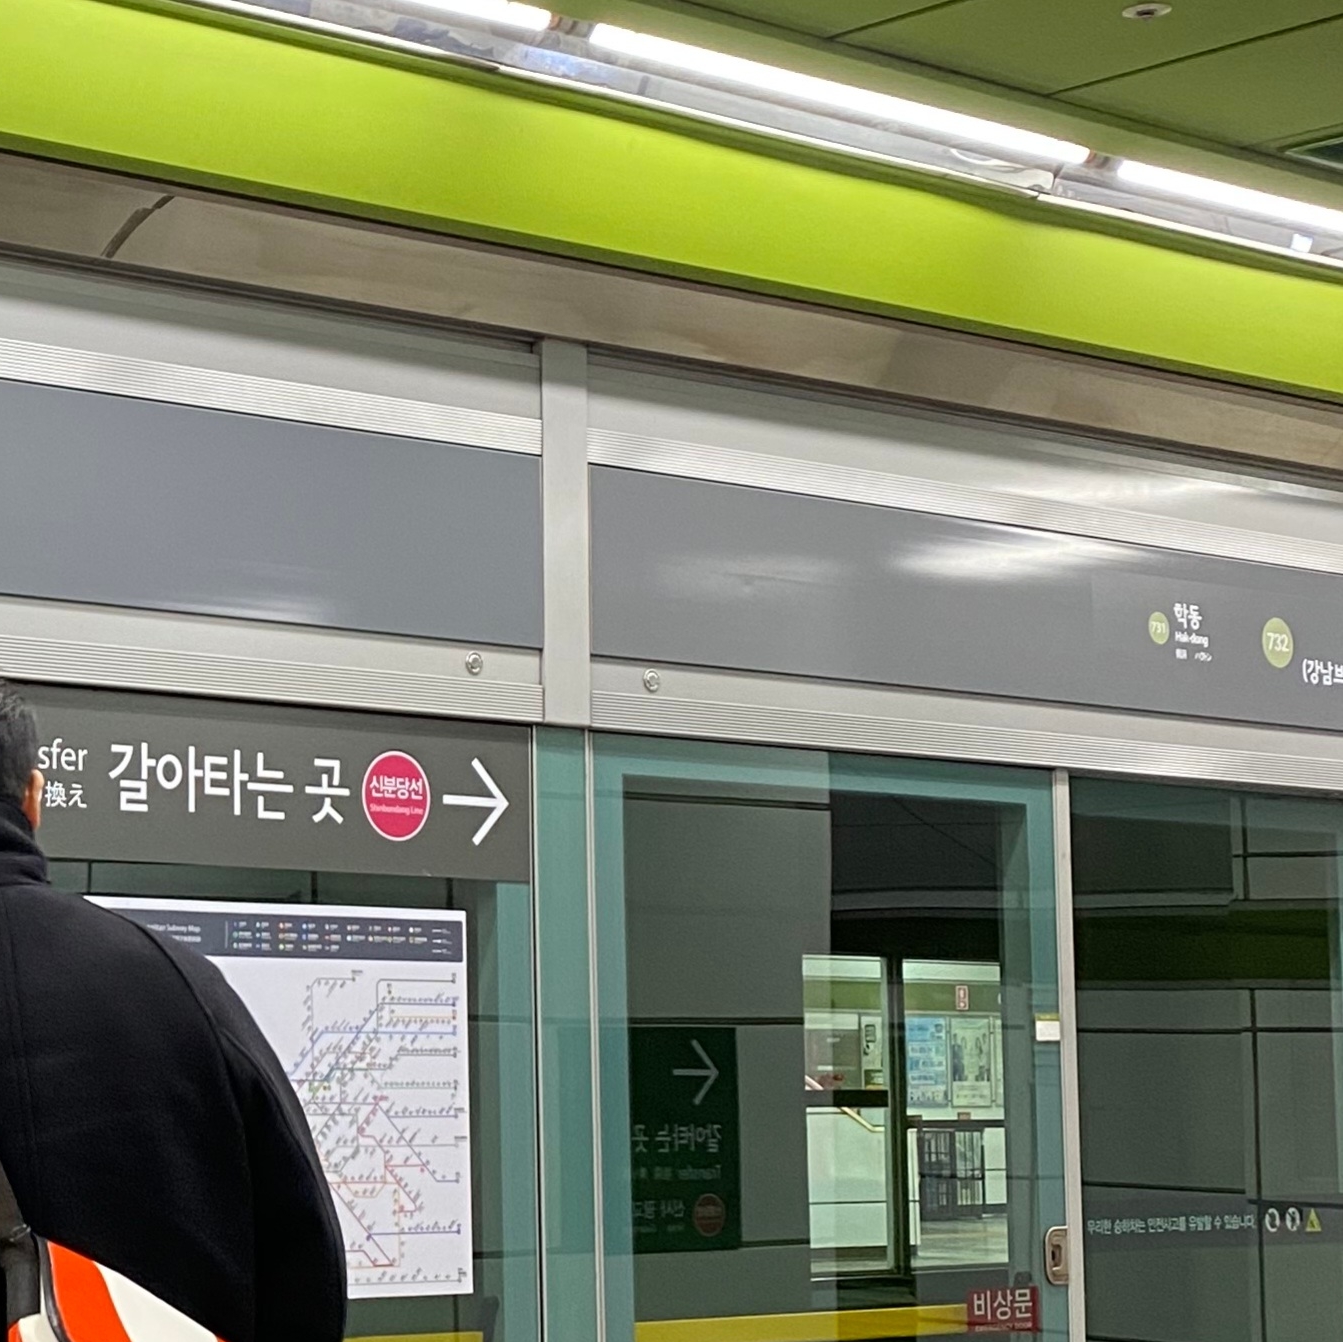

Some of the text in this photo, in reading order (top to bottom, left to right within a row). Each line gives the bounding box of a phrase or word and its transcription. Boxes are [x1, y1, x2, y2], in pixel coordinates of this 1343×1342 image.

[1151, 621, 1166, 634] 731
[1173, 603, 1203, 630] 학동
[1266, 632, 1290, 652] 732
[108, 741, 351, 824] 갈아타는 곳
[369, 775, 423, 800] 신분당선
[973, 1288, 1033, 1320] 비상문
